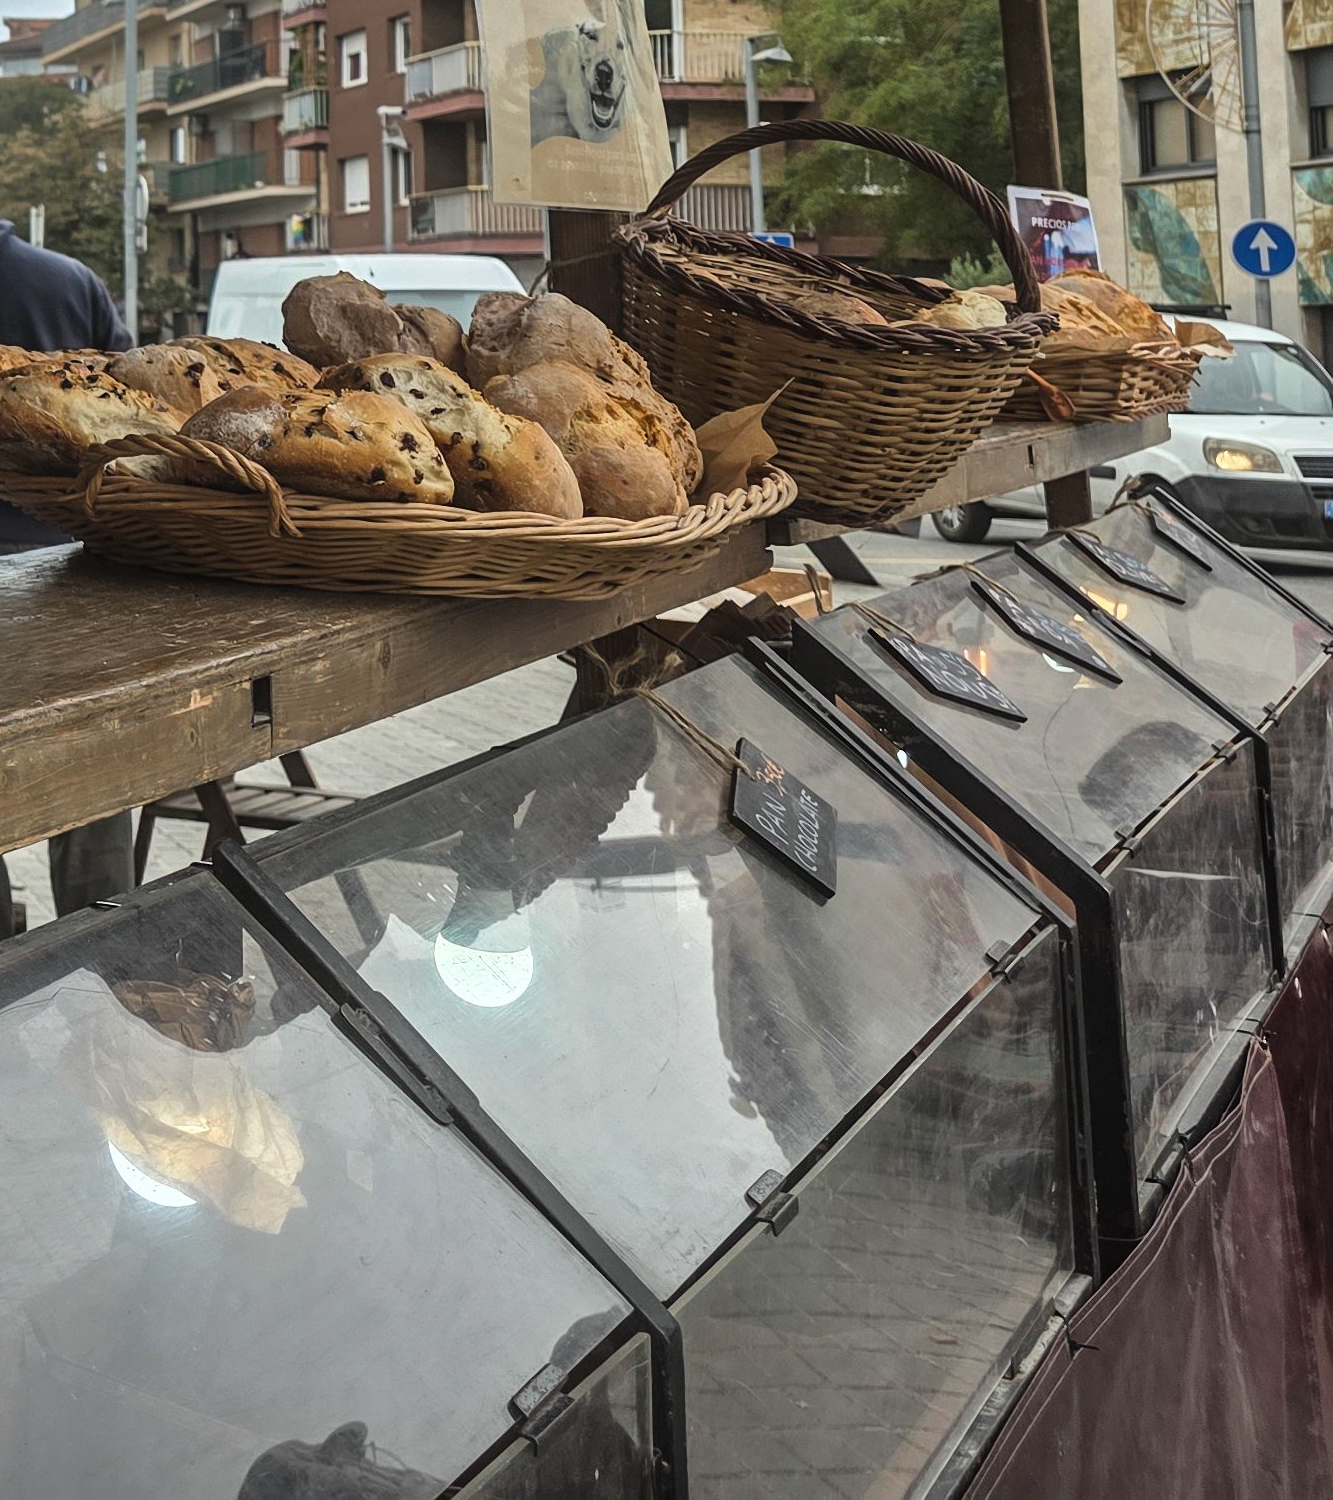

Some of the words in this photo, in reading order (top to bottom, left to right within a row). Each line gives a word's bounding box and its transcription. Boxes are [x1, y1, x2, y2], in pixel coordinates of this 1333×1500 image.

[1031, 216, 1067, 230] PRECIOS
[755, 792, 790, 846] PAN
[794, 788, 820, 873] CHOCOLATE
